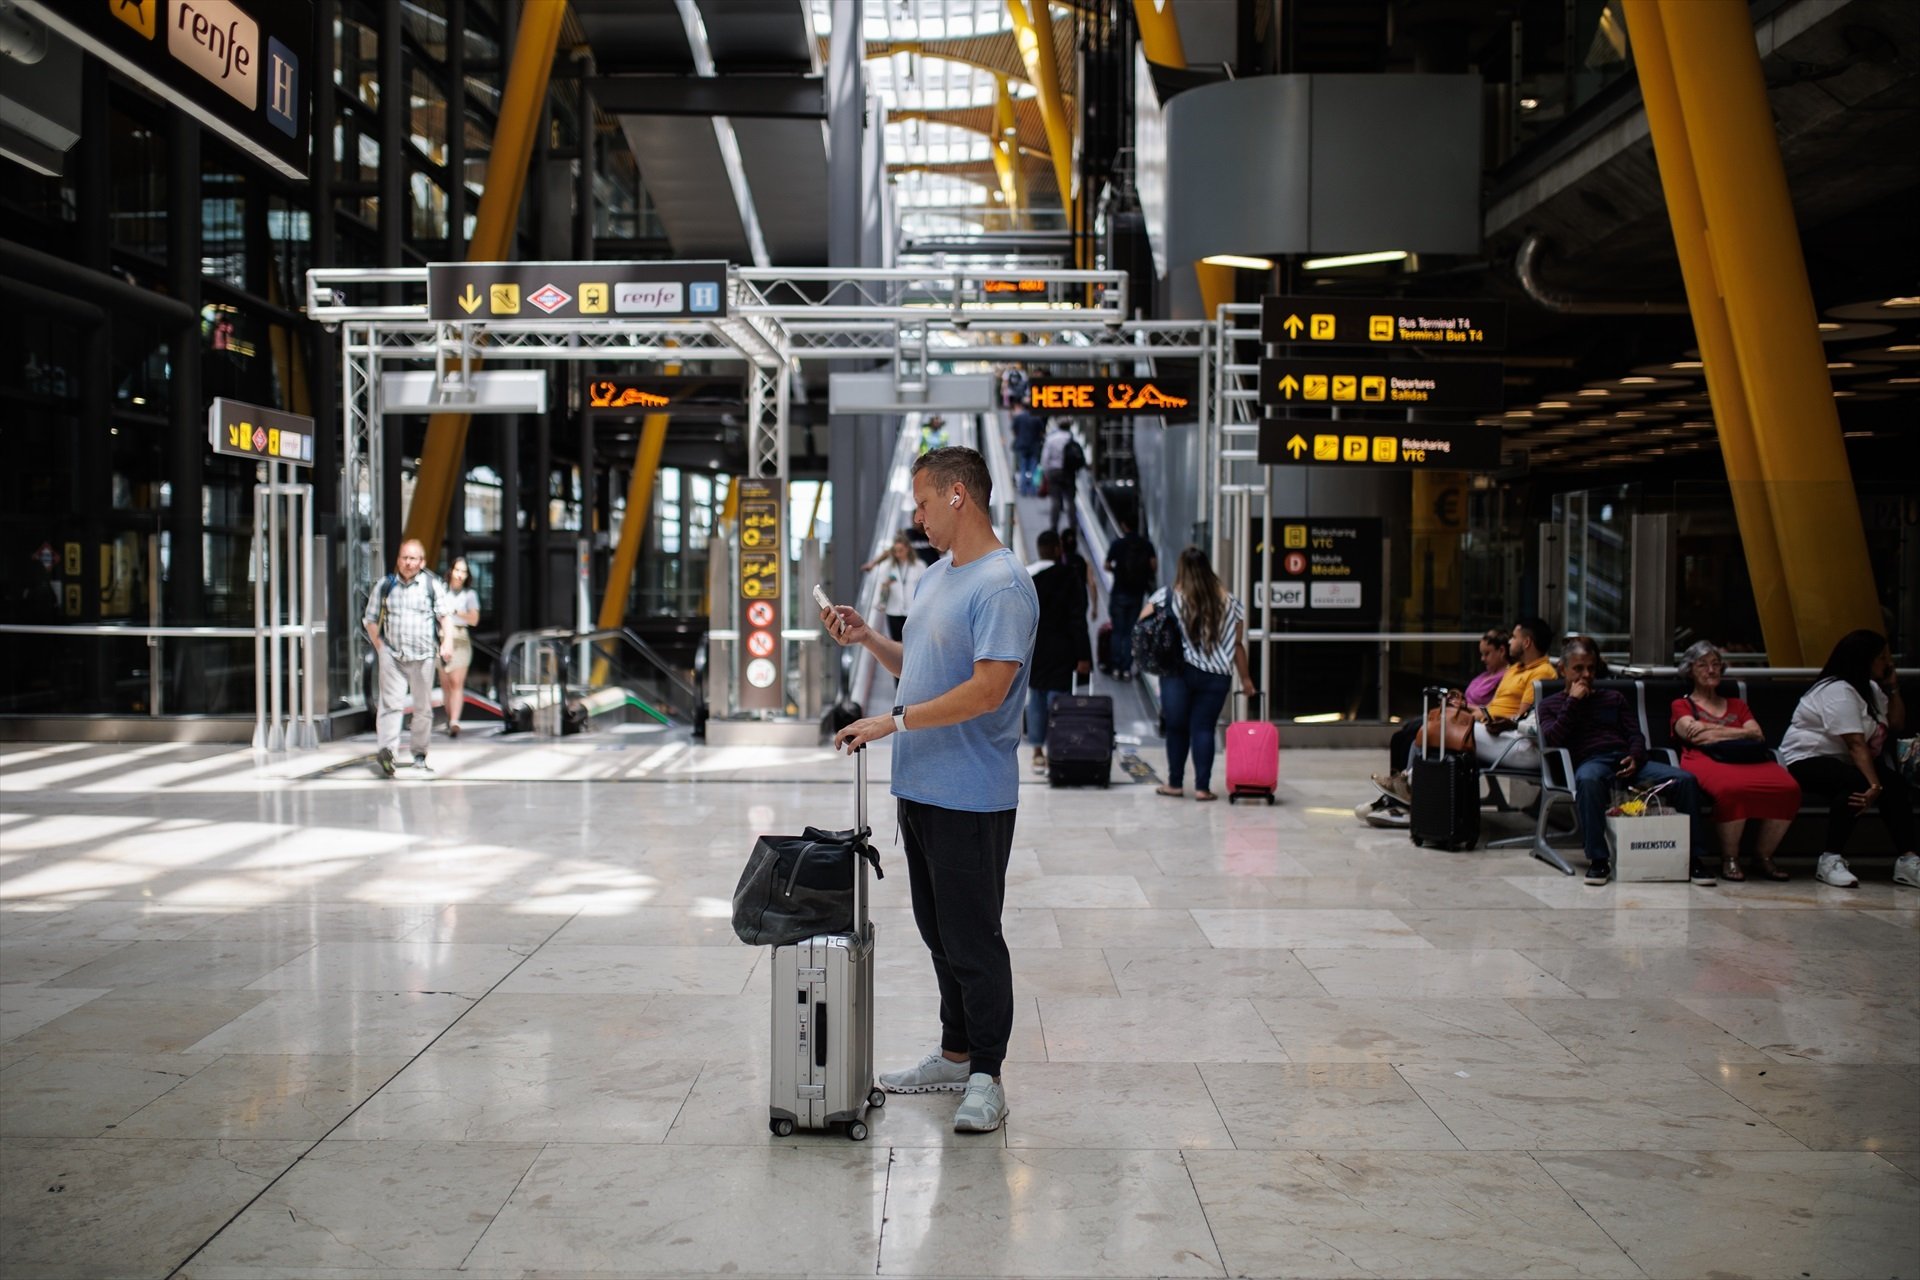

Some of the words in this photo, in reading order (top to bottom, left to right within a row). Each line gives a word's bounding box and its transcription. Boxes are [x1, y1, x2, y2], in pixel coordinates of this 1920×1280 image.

[178, 2, 250, 79] renfe
[271, 54, 294, 121] H
[622, 287, 675, 308] renfe
[695, 287, 713, 306] H
[1398, 317, 1417, 329] Bus
[1418, 317, 1456, 329] Terminal
[1457, 318, 1471, 330] T4
[1399, 328, 1444, 341] Terminal
[1446, 329, 1467, 342] Bus
[1469, 330, 1483, 342] T4
[1390, 376, 1436, 390] Departures
[1032, 385, 1095, 408] HERE
[1391, 389, 1428, 401] Salidas
[1402, 438, 1451, 453] Ridesharing
[1402, 450, 1426, 462] VTC
[1312, 538, 1334, 549] VTC
[1289, 556, 1302, 572] D
[1630, 840, 1677, 851] BIRKENSTOCK
